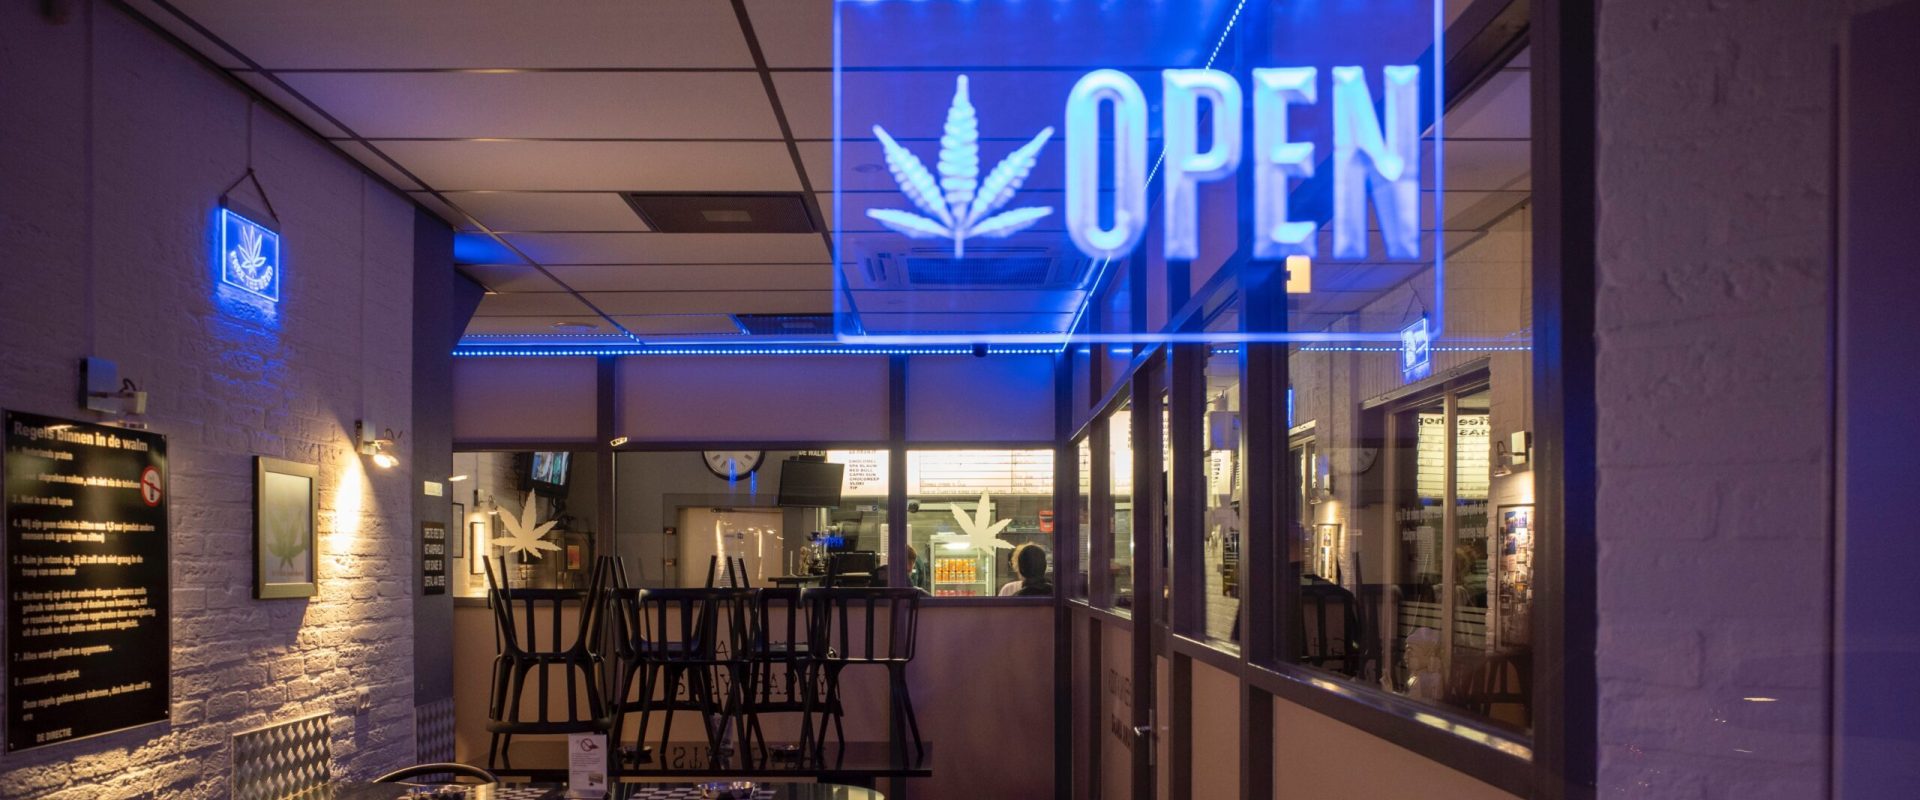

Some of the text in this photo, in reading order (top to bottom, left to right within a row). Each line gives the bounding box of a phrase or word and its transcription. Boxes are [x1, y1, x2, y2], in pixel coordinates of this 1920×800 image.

[1065, 65, 1421, 260] OPEN
[14, 421, 148, 451] Regels binnen in de walm
[36, 727, 72, 743] DE DIRECTIE
